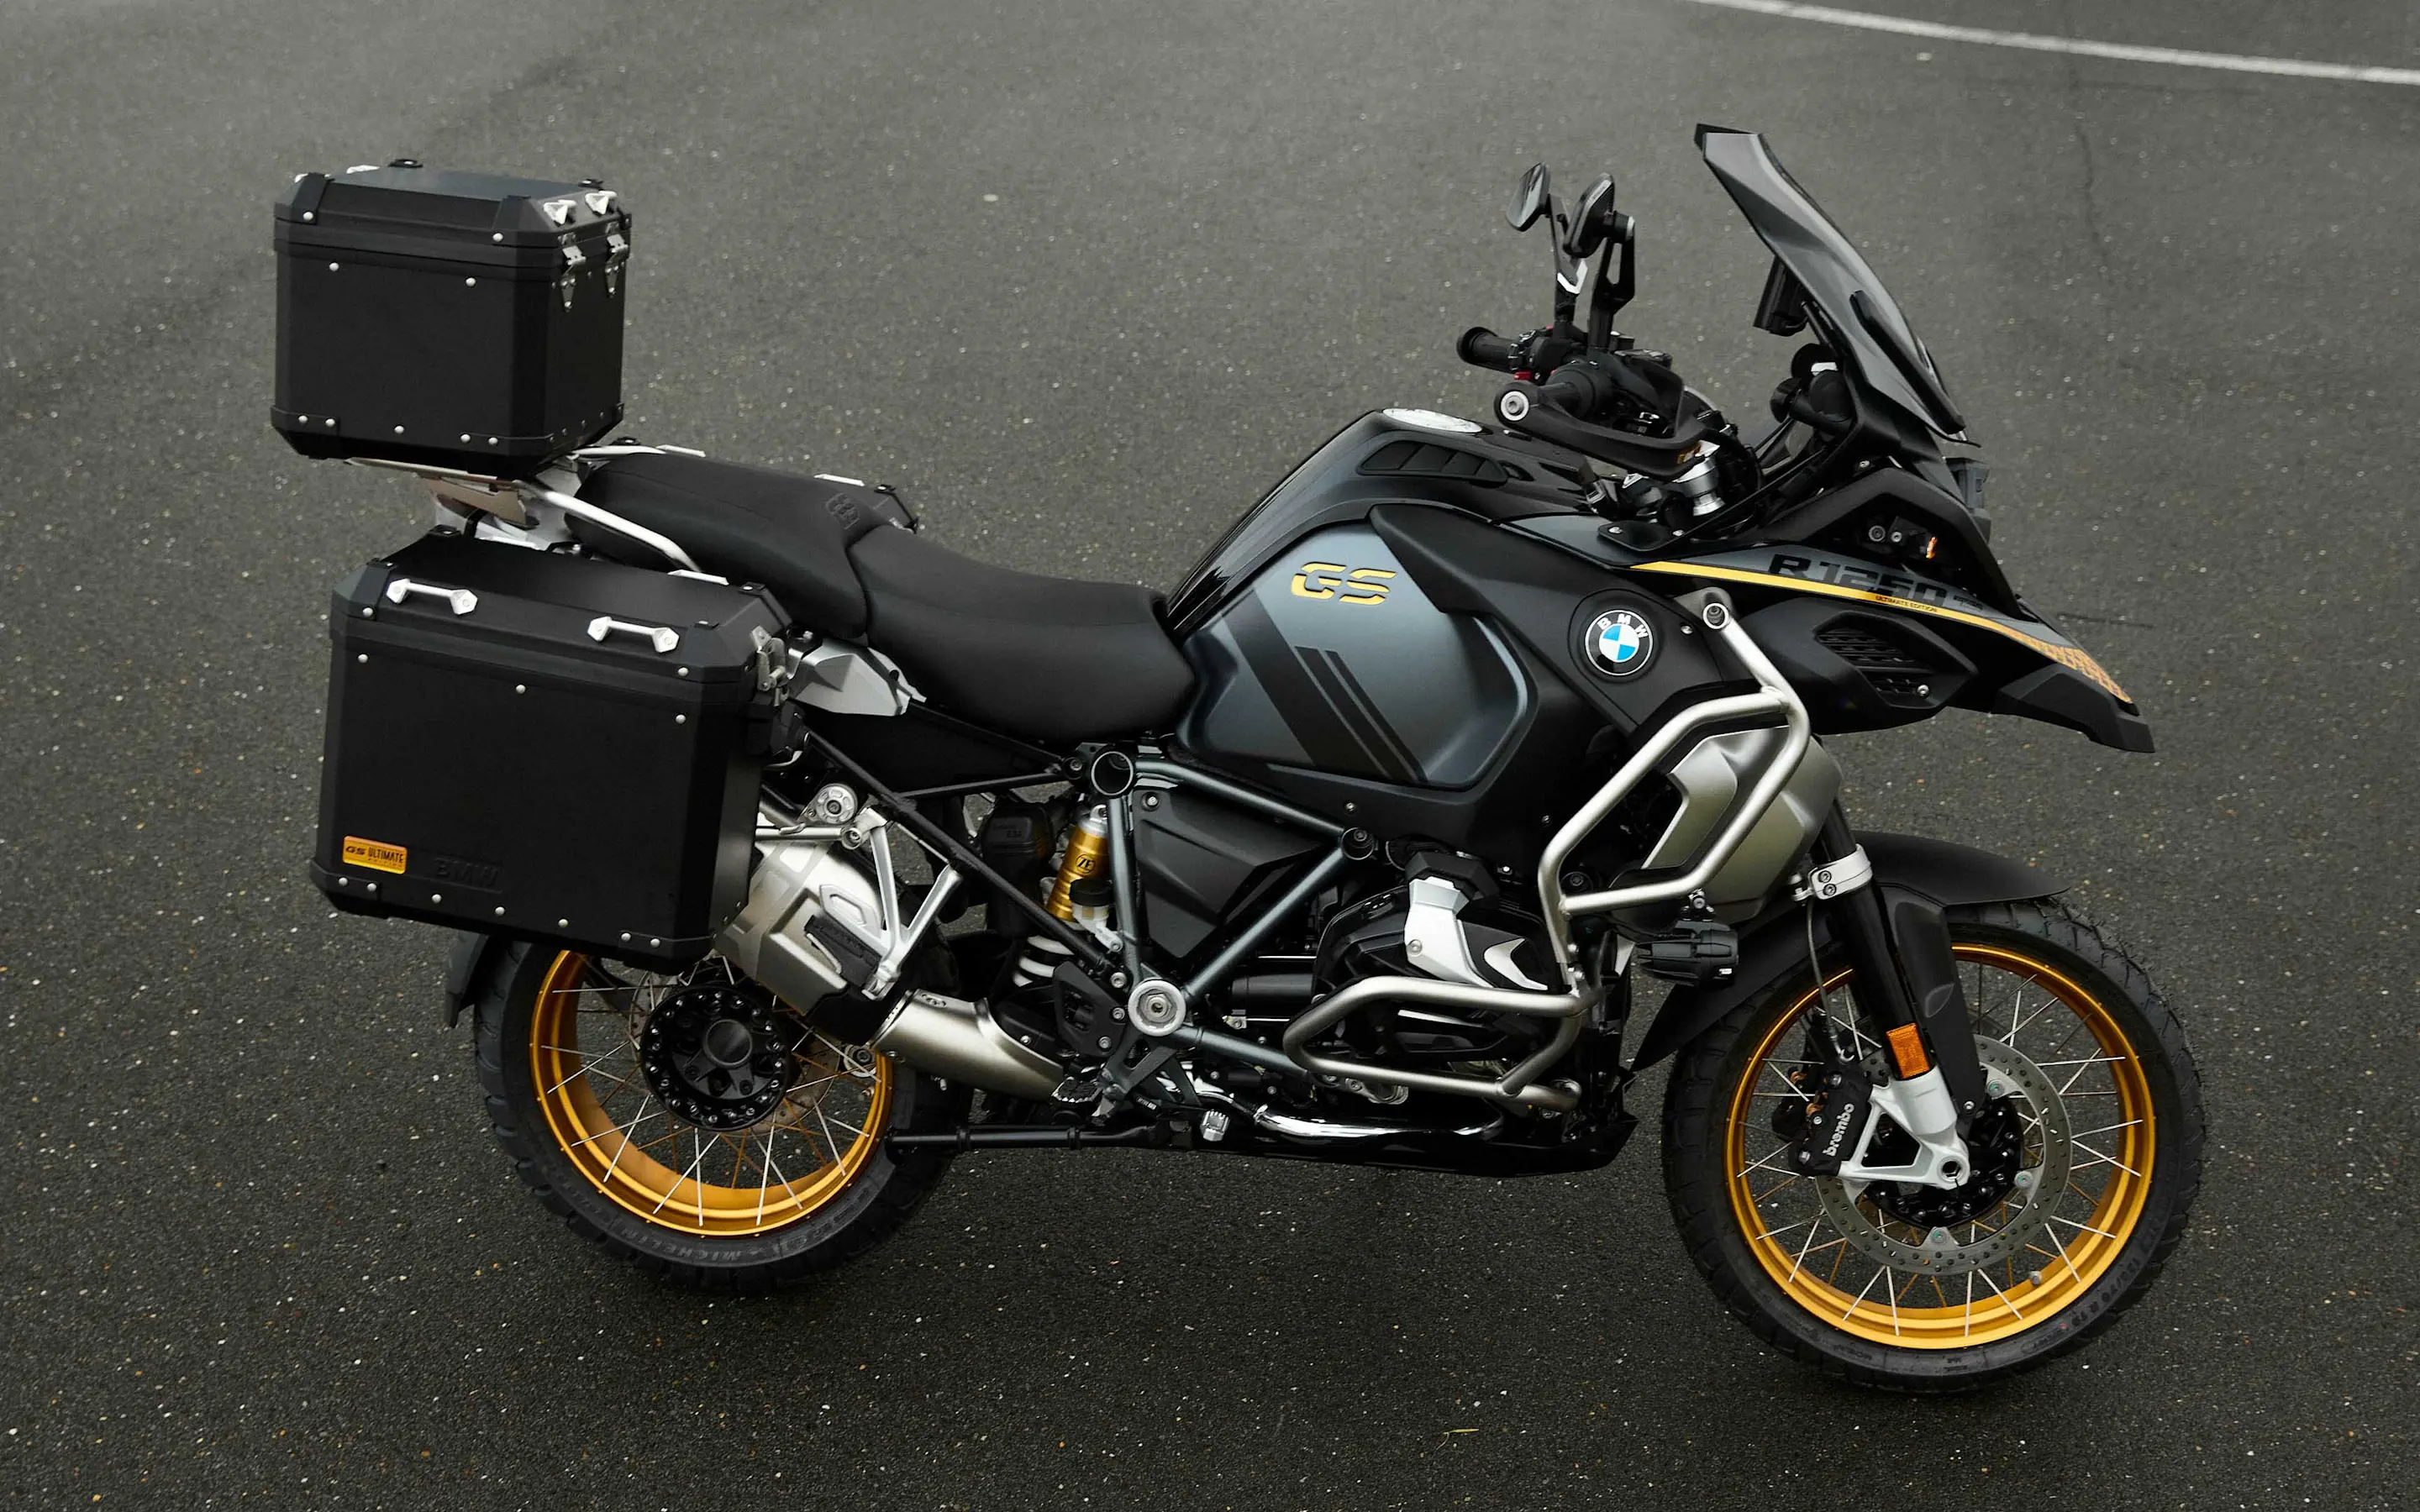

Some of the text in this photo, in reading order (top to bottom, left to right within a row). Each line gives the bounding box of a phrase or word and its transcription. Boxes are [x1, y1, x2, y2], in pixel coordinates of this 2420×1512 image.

[1291, 561, 1397, 606] GS
[1597, 613, 1649, 638] BMW
[345, 845, 366, 856] GS
[368, 847, 404, 864] ULTIMATE
[1823, 1104, 1854, 1157] brembo
[620, 1228, 742, 1261] MICHELIN
